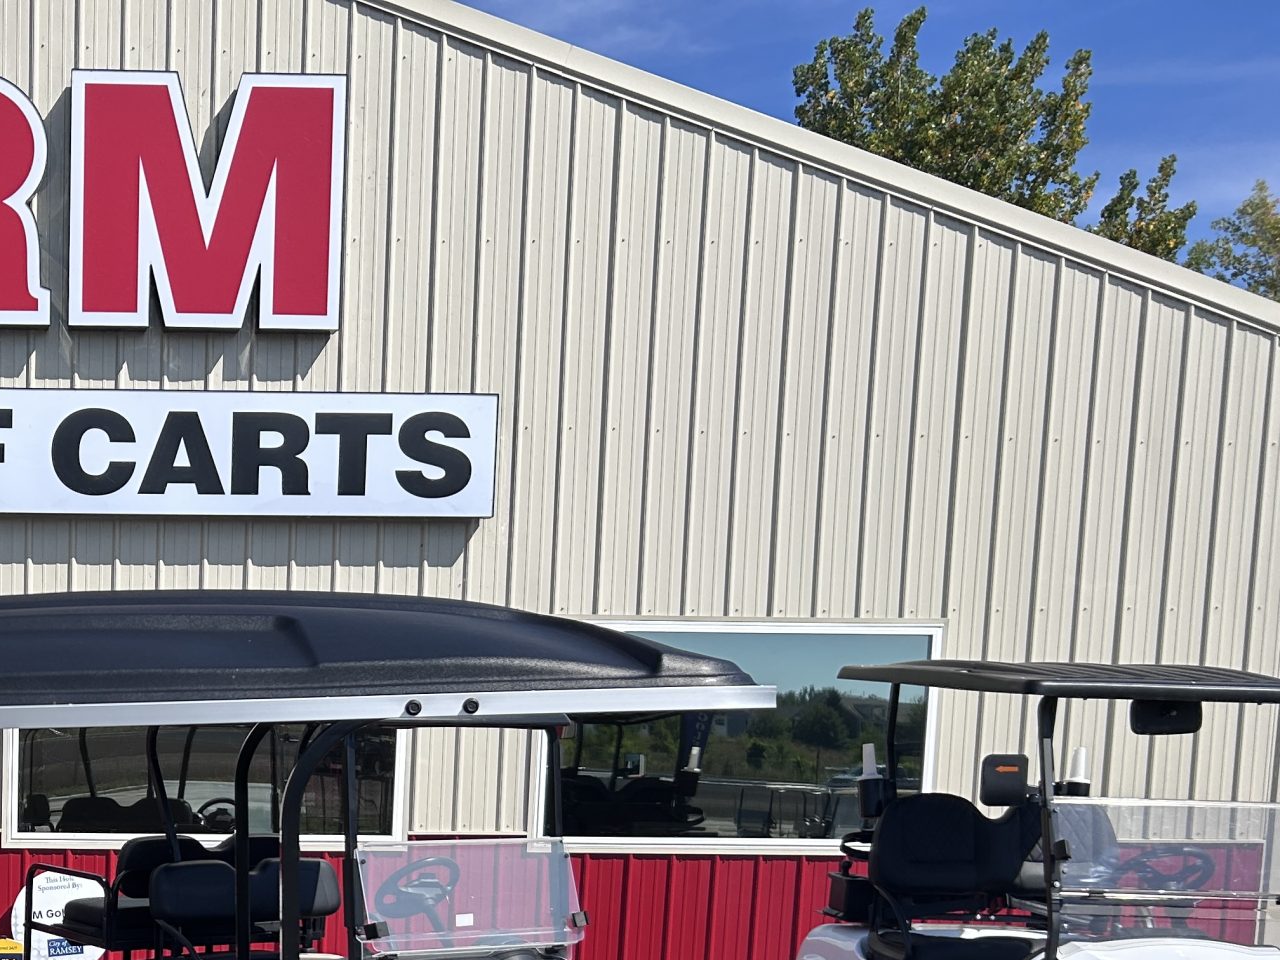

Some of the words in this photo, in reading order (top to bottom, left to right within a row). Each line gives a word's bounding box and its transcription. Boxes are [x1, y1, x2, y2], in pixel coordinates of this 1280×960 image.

[51, 407, 473, 499] CARTS
[37, 882, 70, 893] Sponsored
[49, 945, 82, 956] RAMSEY
